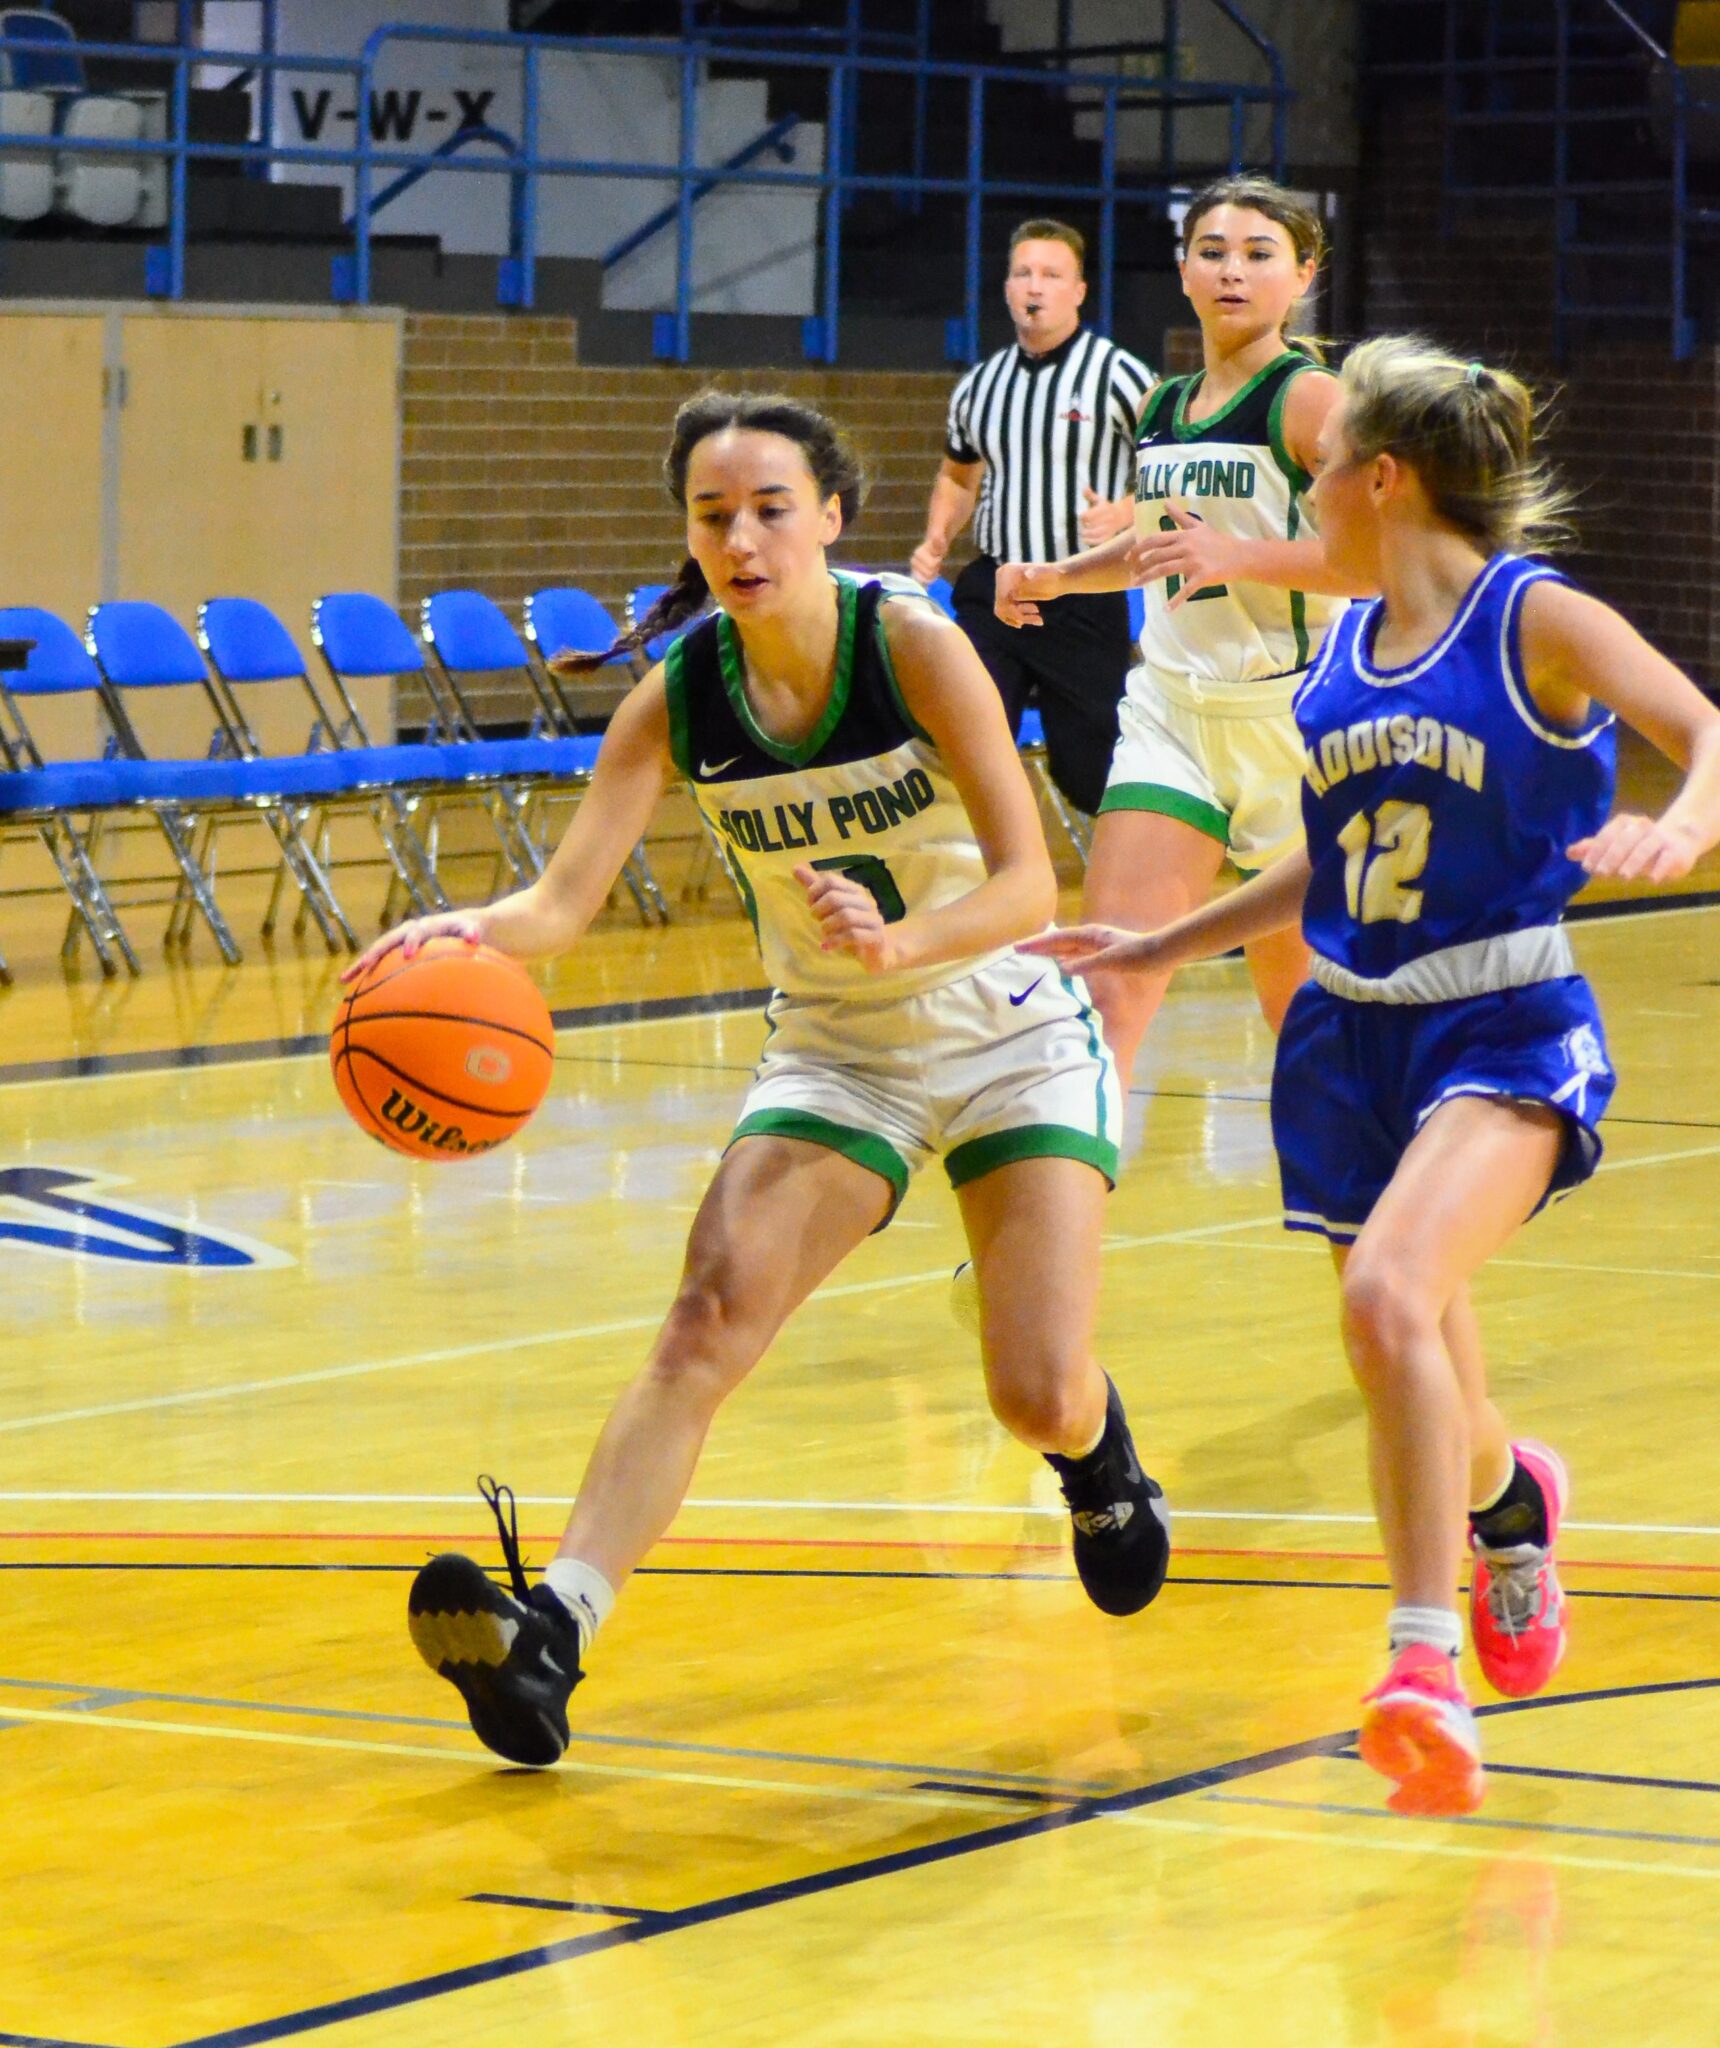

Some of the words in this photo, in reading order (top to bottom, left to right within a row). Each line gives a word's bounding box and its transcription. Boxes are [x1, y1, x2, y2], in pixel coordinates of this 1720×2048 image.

[292, 90, 495, 141] V-W-X
[1135, 463, 1180, 504] OLLY
[1181, 460, 1256, 499] POND
[828, 767, 936, 840] POND
[1337, 799, 1433, 925] 12
